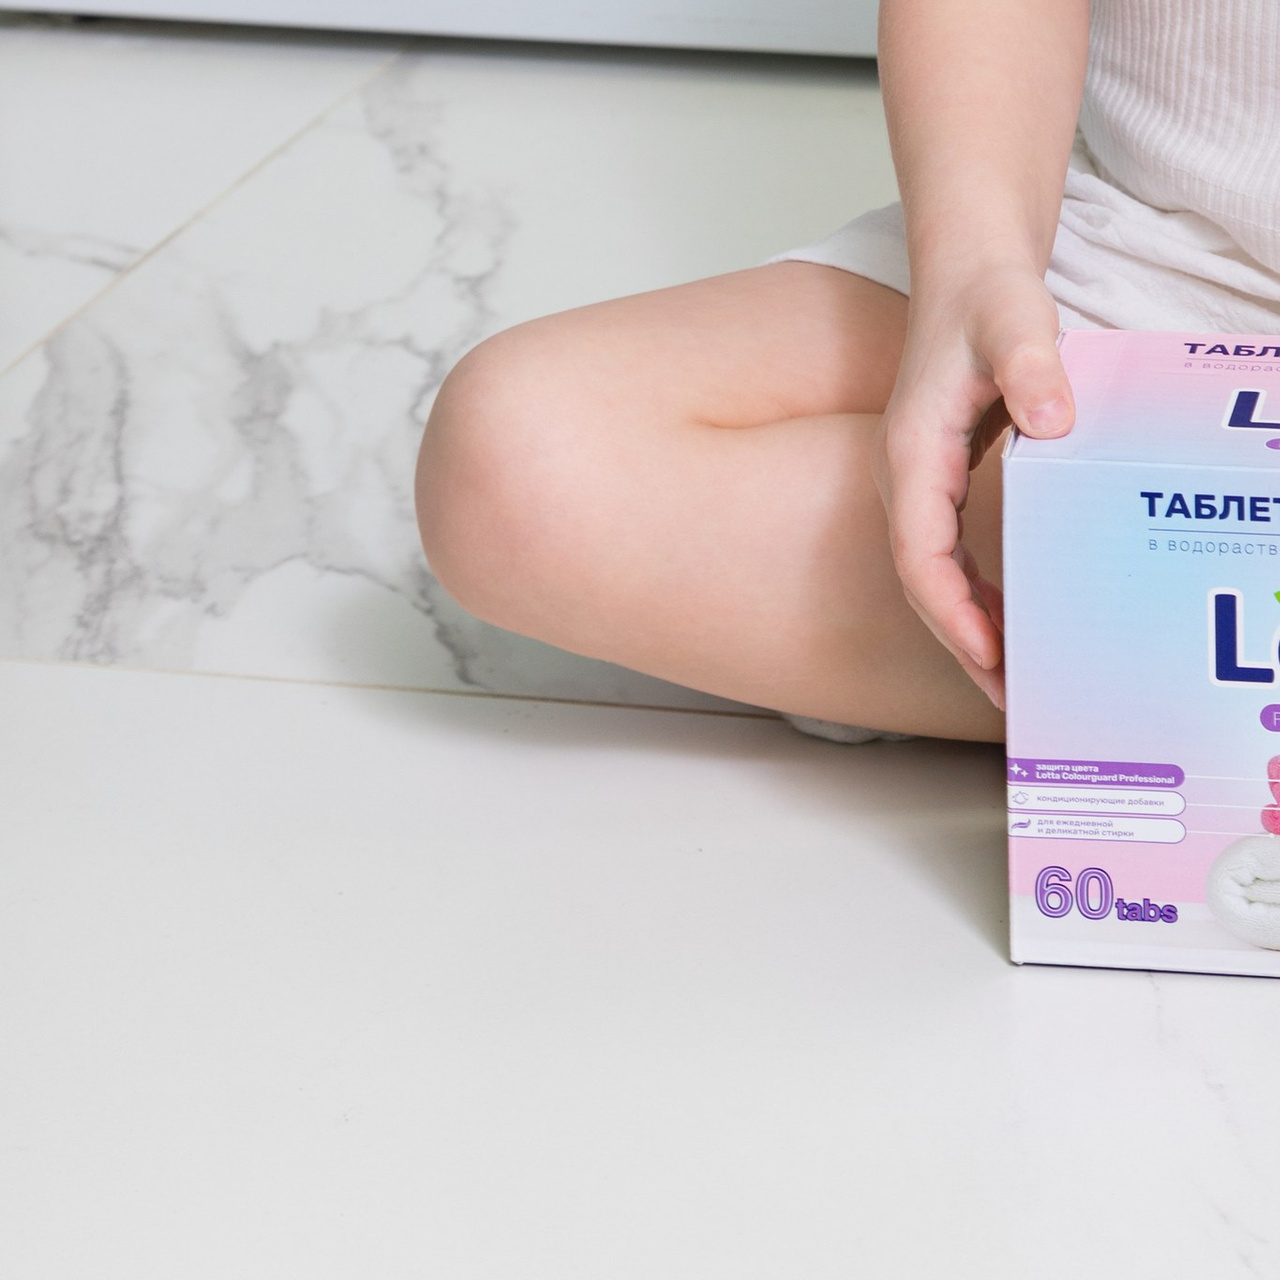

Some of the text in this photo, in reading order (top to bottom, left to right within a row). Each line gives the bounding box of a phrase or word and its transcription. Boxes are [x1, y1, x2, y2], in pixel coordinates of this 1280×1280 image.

[1184, 361, 1193, 369] в
[1149, 539, 1159, 551] в
[1036, 764, 1099, 773] защита цвета
[1036, 771, 1175, 785] Lotta Colourguard Professional
[1036, 795, 1165, 807] кондиционирующие добавки
[1037, 818, 1114, 828] для ежедневной
[1045, 827, 1100, 837] деликатной
[1101, 830, 1135, 839] стирки
